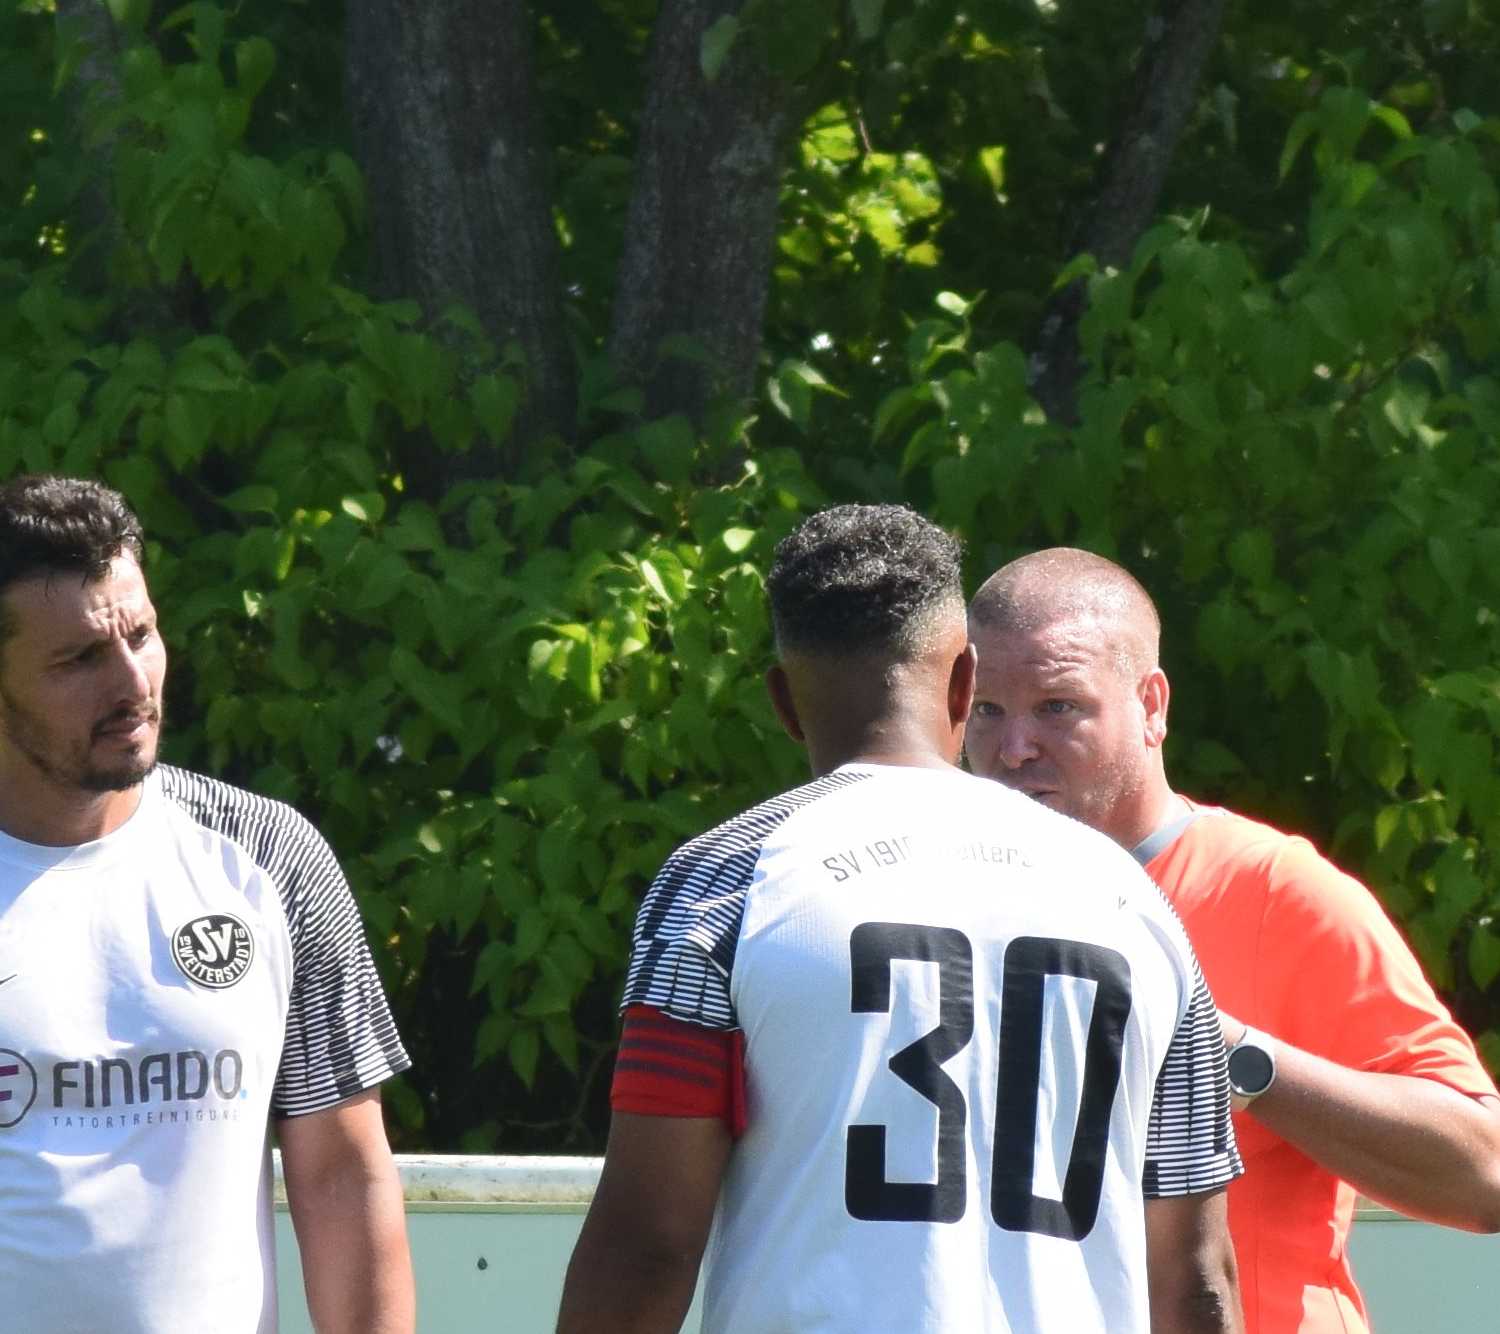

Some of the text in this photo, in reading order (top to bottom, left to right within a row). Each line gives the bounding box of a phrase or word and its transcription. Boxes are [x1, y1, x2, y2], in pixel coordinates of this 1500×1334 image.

[179, 940, 250, 983] WEITERSTADT
[191, 919, 234, 963] SV
[845, 921, 1133, 1243] 30
